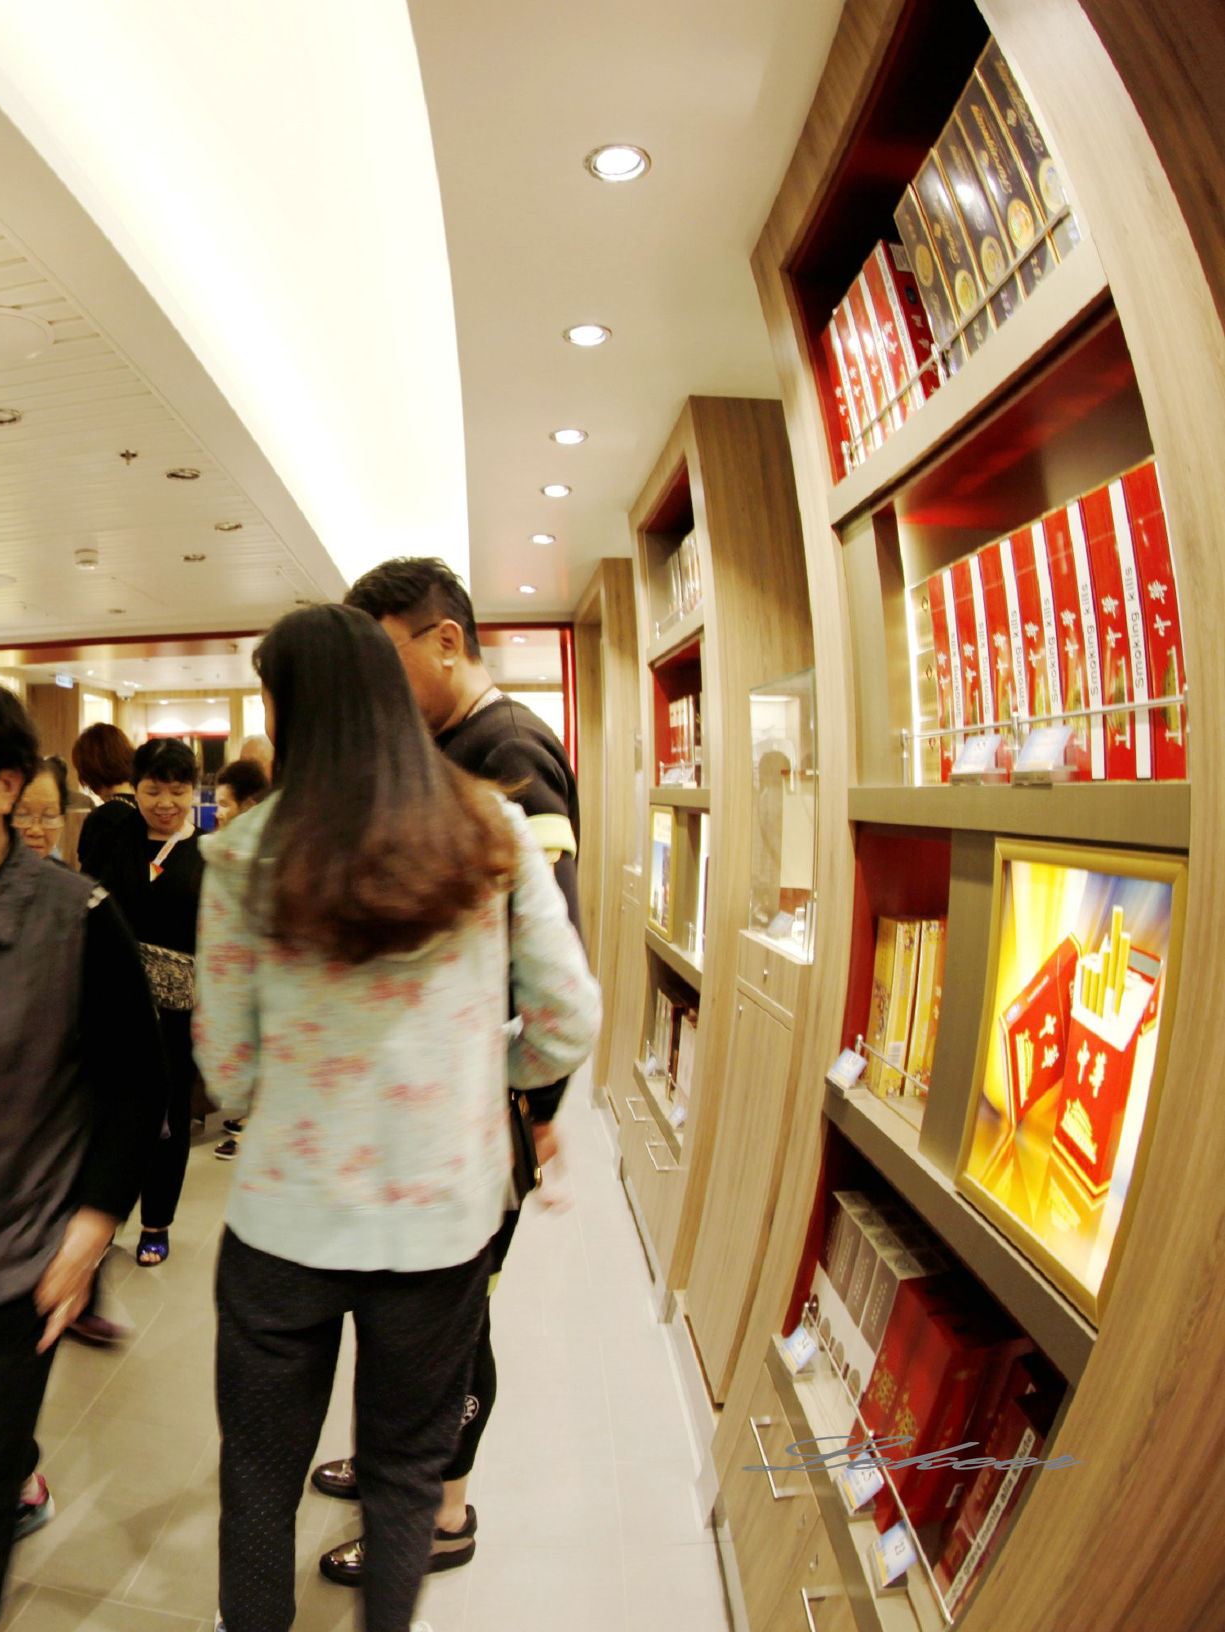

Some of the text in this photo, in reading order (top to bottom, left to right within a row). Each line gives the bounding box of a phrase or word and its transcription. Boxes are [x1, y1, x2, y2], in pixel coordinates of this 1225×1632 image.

[1010, 611, 1027, 709] Smoking kills
[1043, 598, 1059, 703] Smoking kills
[1080, 584, 1100, 697] Smoking kills
[1124, 567, 1145, 689] Smoking kills
